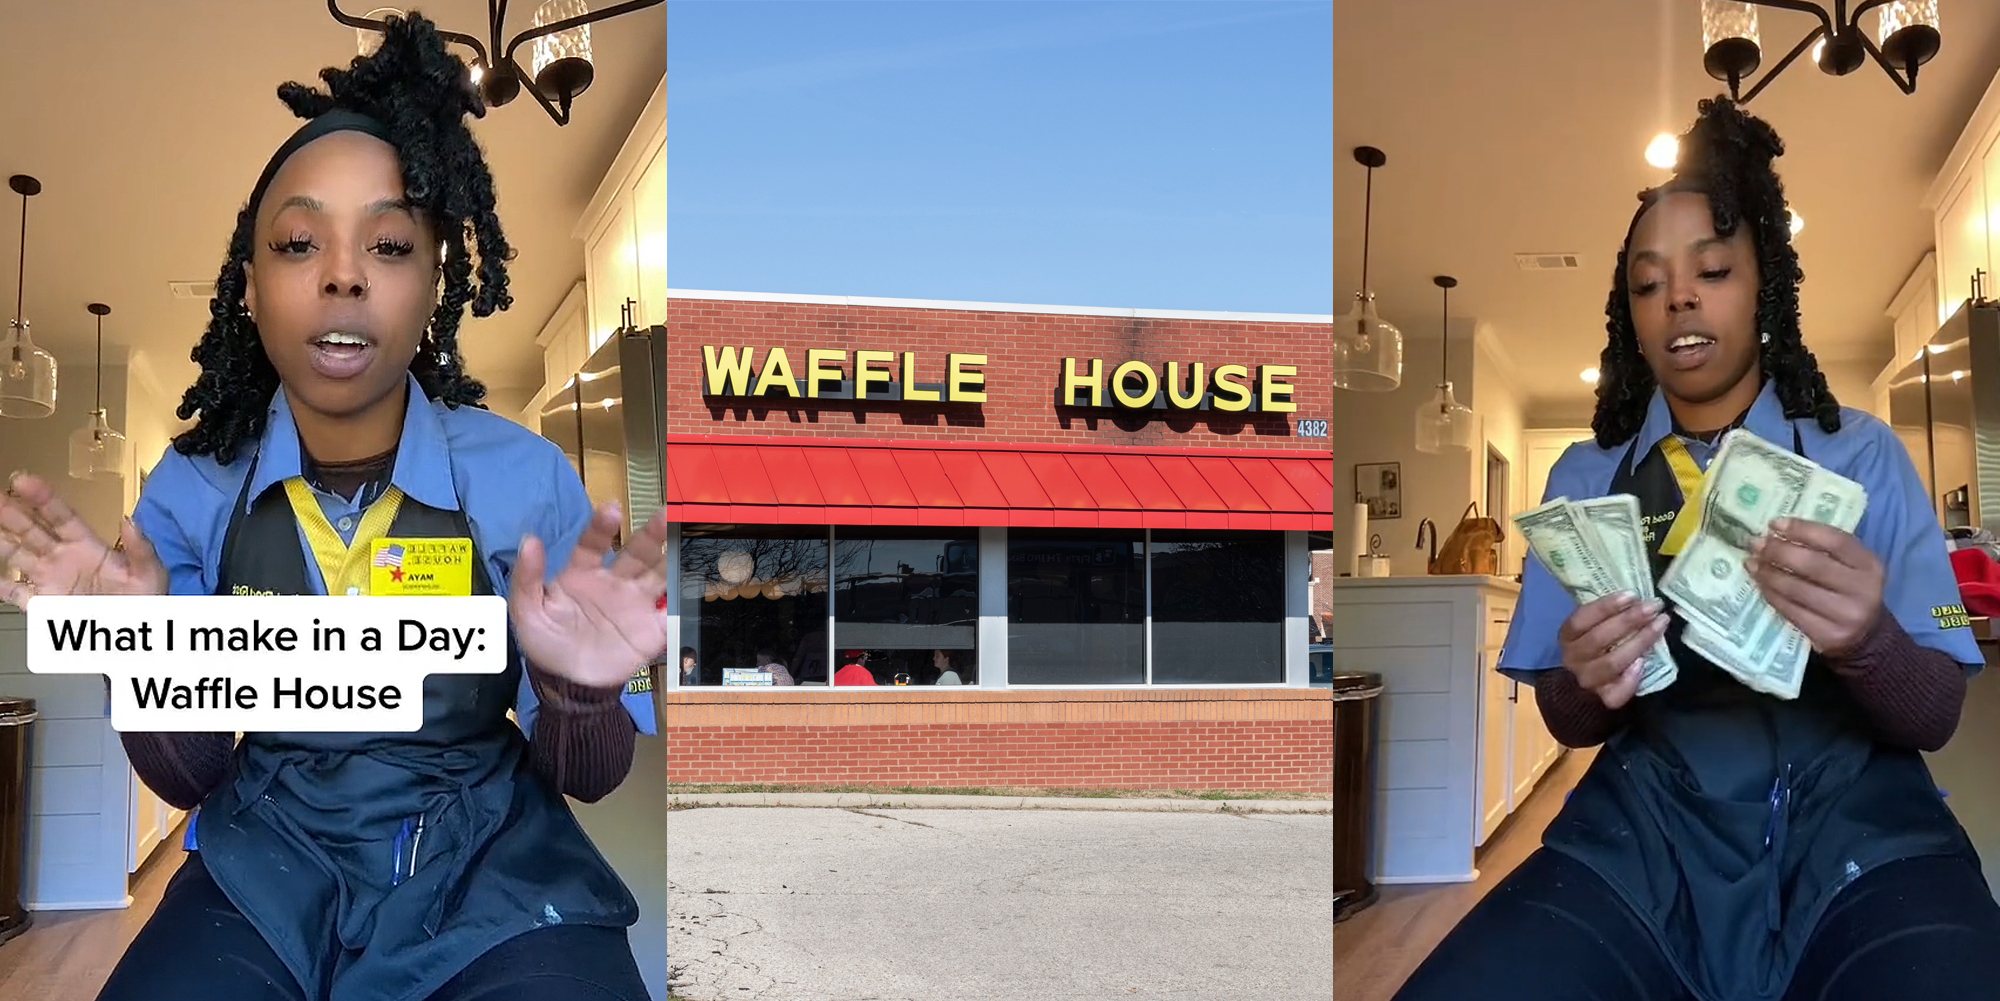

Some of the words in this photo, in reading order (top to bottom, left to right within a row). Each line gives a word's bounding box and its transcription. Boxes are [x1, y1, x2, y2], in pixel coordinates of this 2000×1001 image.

[703, 345, 988, 403] WAFFLE
[1064, 357, 1298, 412] HOUSE
[1297, 420, 1328, 437] 4382
